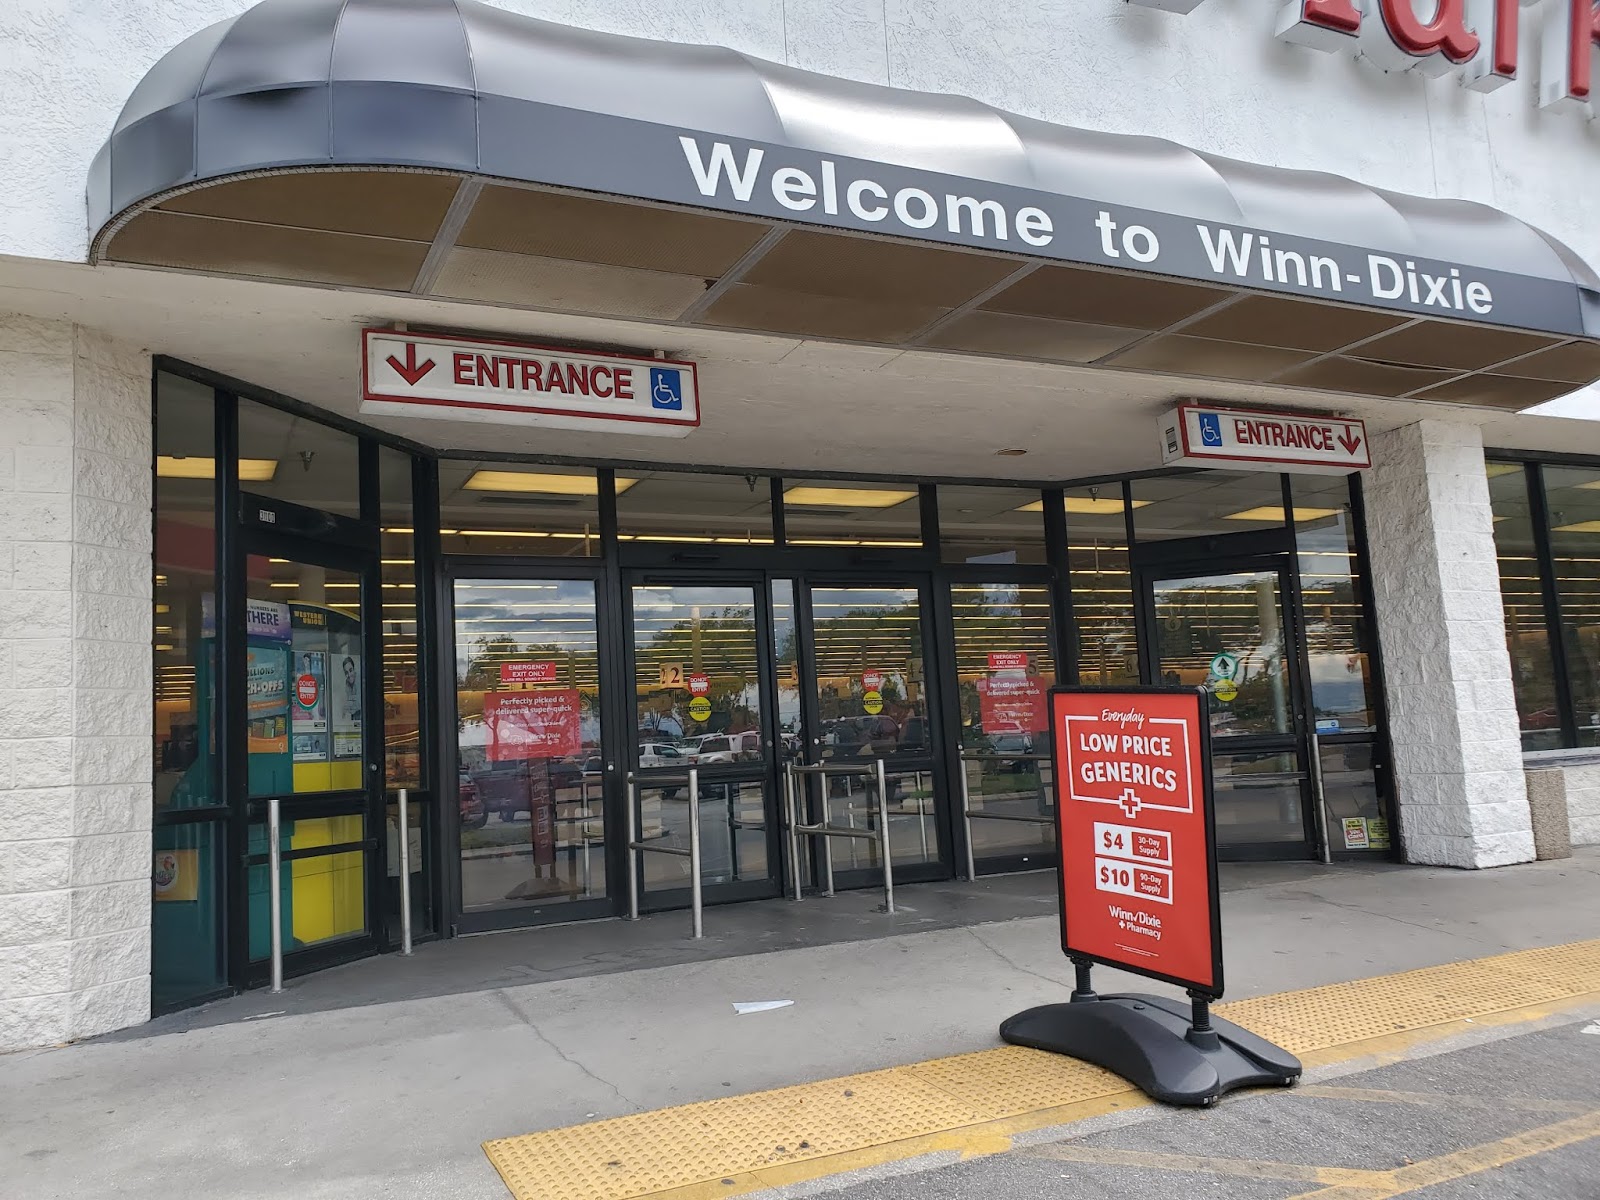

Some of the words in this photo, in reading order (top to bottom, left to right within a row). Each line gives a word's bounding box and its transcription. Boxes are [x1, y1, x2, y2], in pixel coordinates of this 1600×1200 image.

[678, 136, 1054, 247] Welcome
[1095, 211, 1160, 263] to
[1196, 225, 1493, 314] Winn-Dixie
[453, 353, 634, 399] ENTRANCE
[1234, 419, 1336, 451] ENTRANCE
[294, 610, 322, 620] WESTERN
[670, 666, 680, 683] 2
[1029, 660, 1036, 674] 5
[500, 697, 533, 706] Perfectly
[534, 696, 558, 705] picked
[530, 705, 572, 714] super-quick
[1102, 708, 1144, 730] Everyday
[1080, 732, 1118, 753] LOW
[1122, 735, 1173, 757] PRICE
[1080, 762, 1177, 792] GENERICS
[1103, 830, 1124, 850] $4
[1138, 836, 1160, 848] 30-Day
[1101, 865, 1130, 886] $10
[1140, 873, 1161, 885] 90-Day
[1126, 922, 1161, 940] Pharmacy
